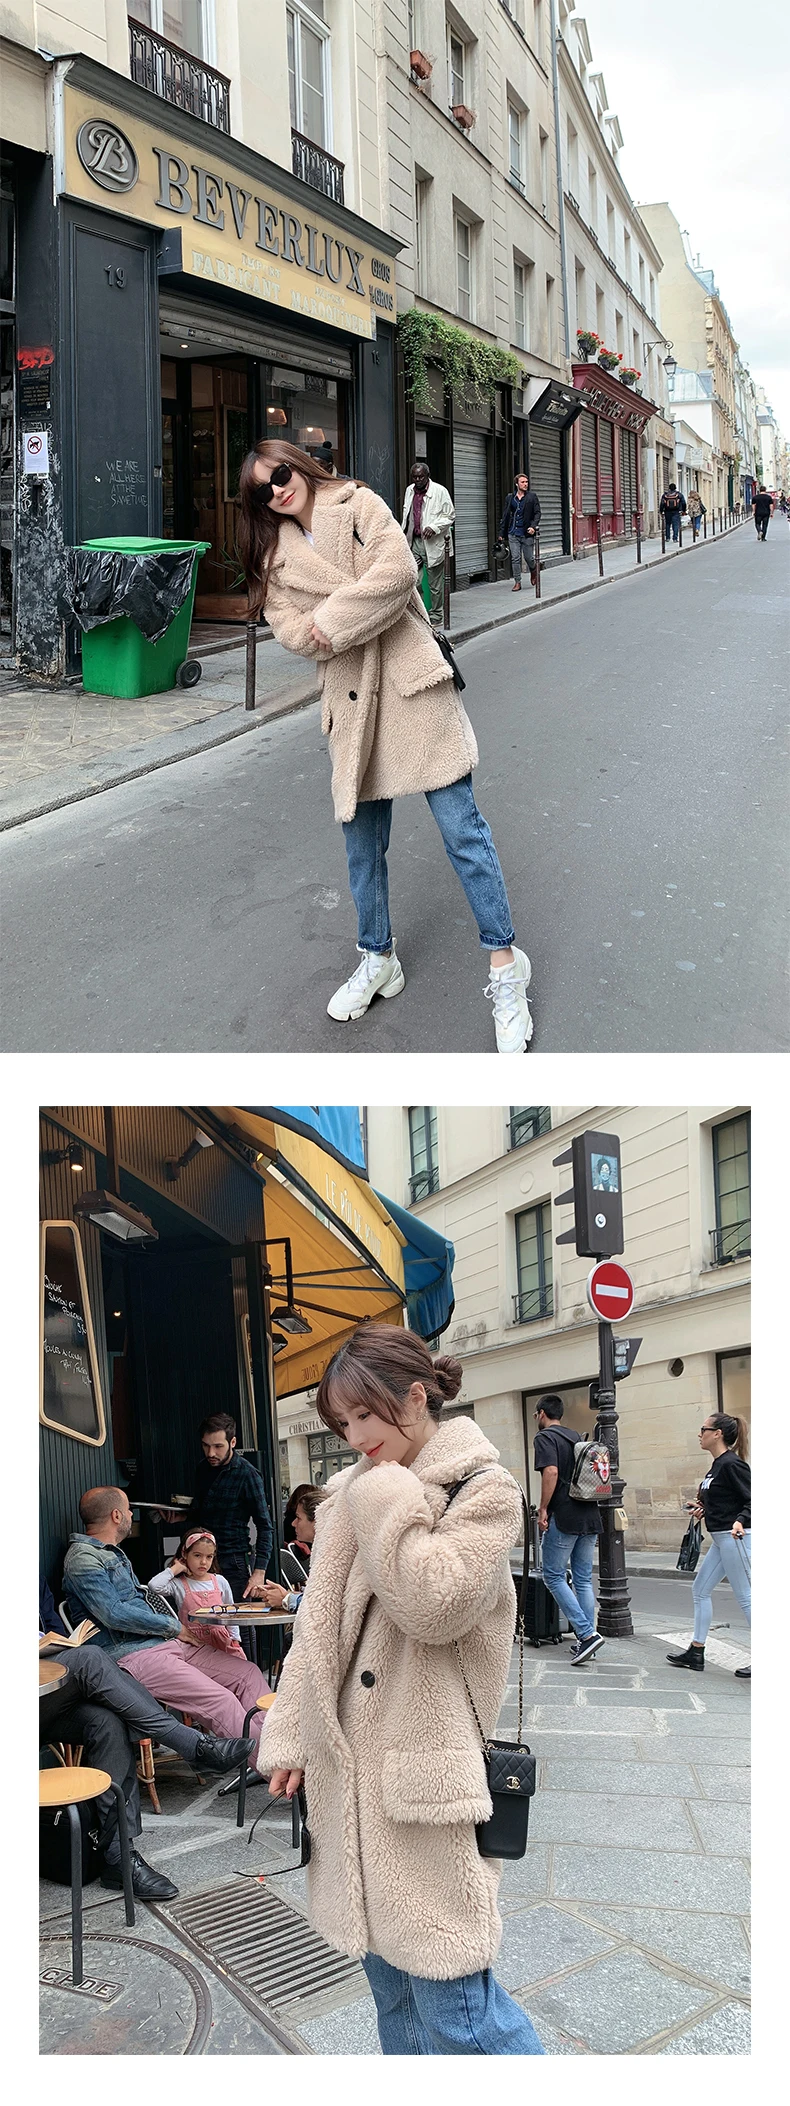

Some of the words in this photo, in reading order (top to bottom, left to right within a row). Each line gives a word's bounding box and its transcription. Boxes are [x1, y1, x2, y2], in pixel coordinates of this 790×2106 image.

[152, 146, 366, 296] BEVERLUX
[103, 264, 127, 289] 19
[191, 250, 281, 301] FABRICANT
[371, 258, 391, 283] GROS
[105, 460, 123, 472] WE
[325, 1172, 338, 1210] LE
[289, 1419, 325, 1436] CHRISTIAN
